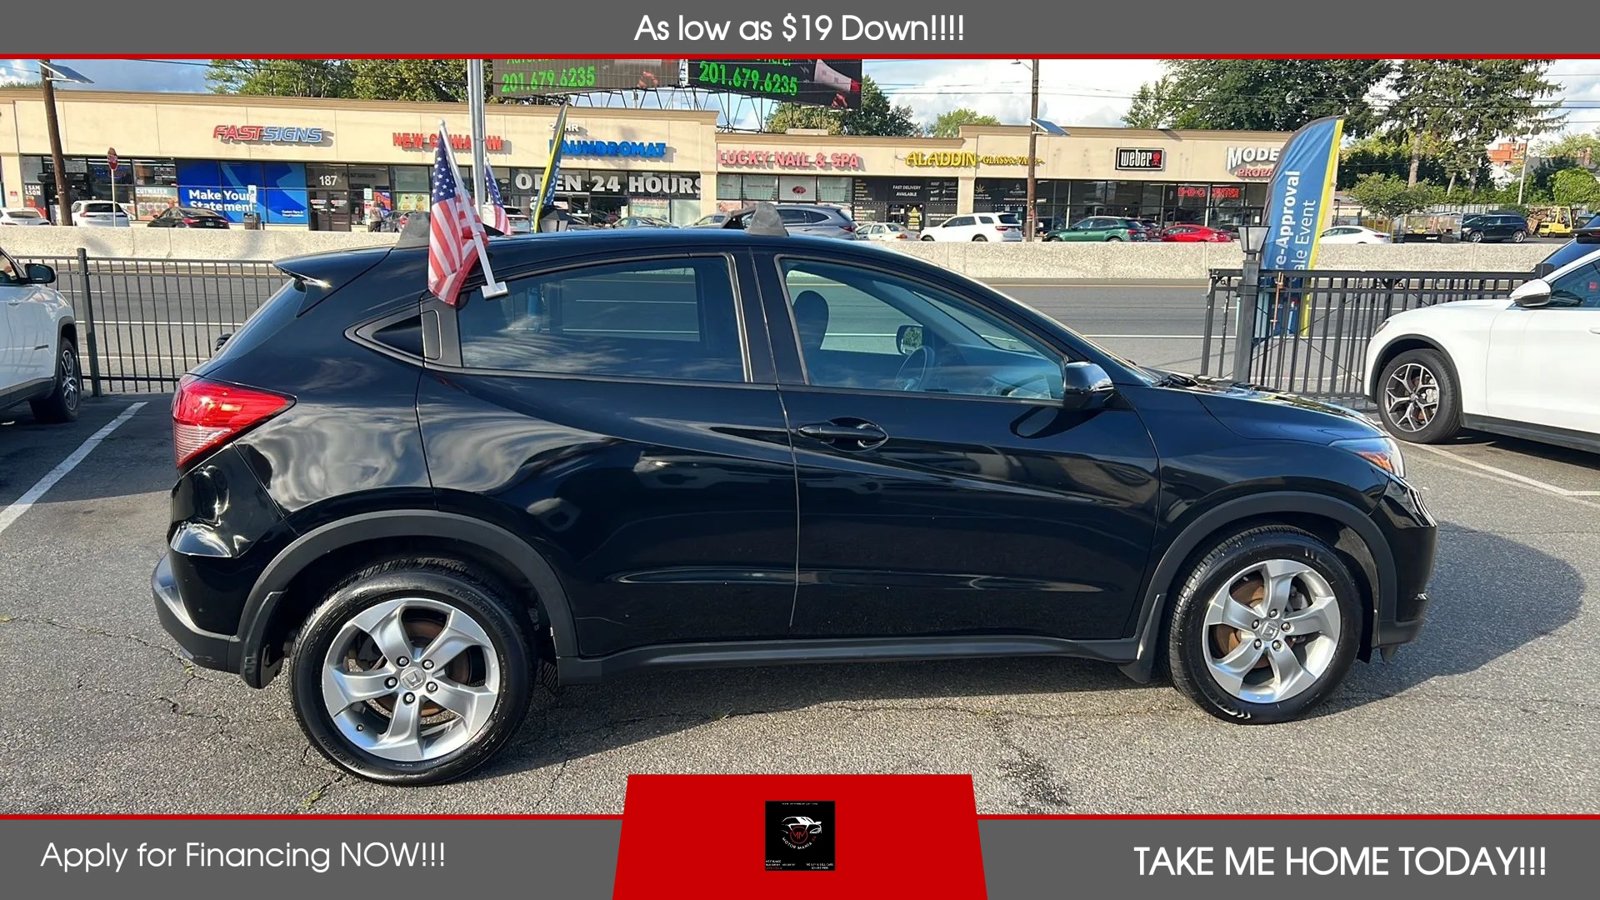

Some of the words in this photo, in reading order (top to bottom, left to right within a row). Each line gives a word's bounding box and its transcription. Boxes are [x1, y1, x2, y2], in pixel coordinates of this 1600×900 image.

[501, 65, 596, 92] 201.679.6235
[700, 60, 798, 96] 201.679.6235
[213, 125, 323, 142] FASTSIGNS
[392, 132, 424, 148] NEW
[718, 149, 769, 166] LUCKY
[774, 151, 810, 167] NAIL
[815, 152, 826, 167] &
[831, 152, 859, 168] SPA
[905, 151, 977, 168] ALADDIN
[1120, 148, 1152, 167] weber
[1226, 147, 1280, 172] MODE
[319, 175, 338, 186] 187
[591, 175, 620, 192] 24
[189, 189, 222, 200] Make
[1274, 170, 1300, 270] re-Approval
[1295, 199, 1317, 245] Event
[1291, 249, 1308, 270] ale
